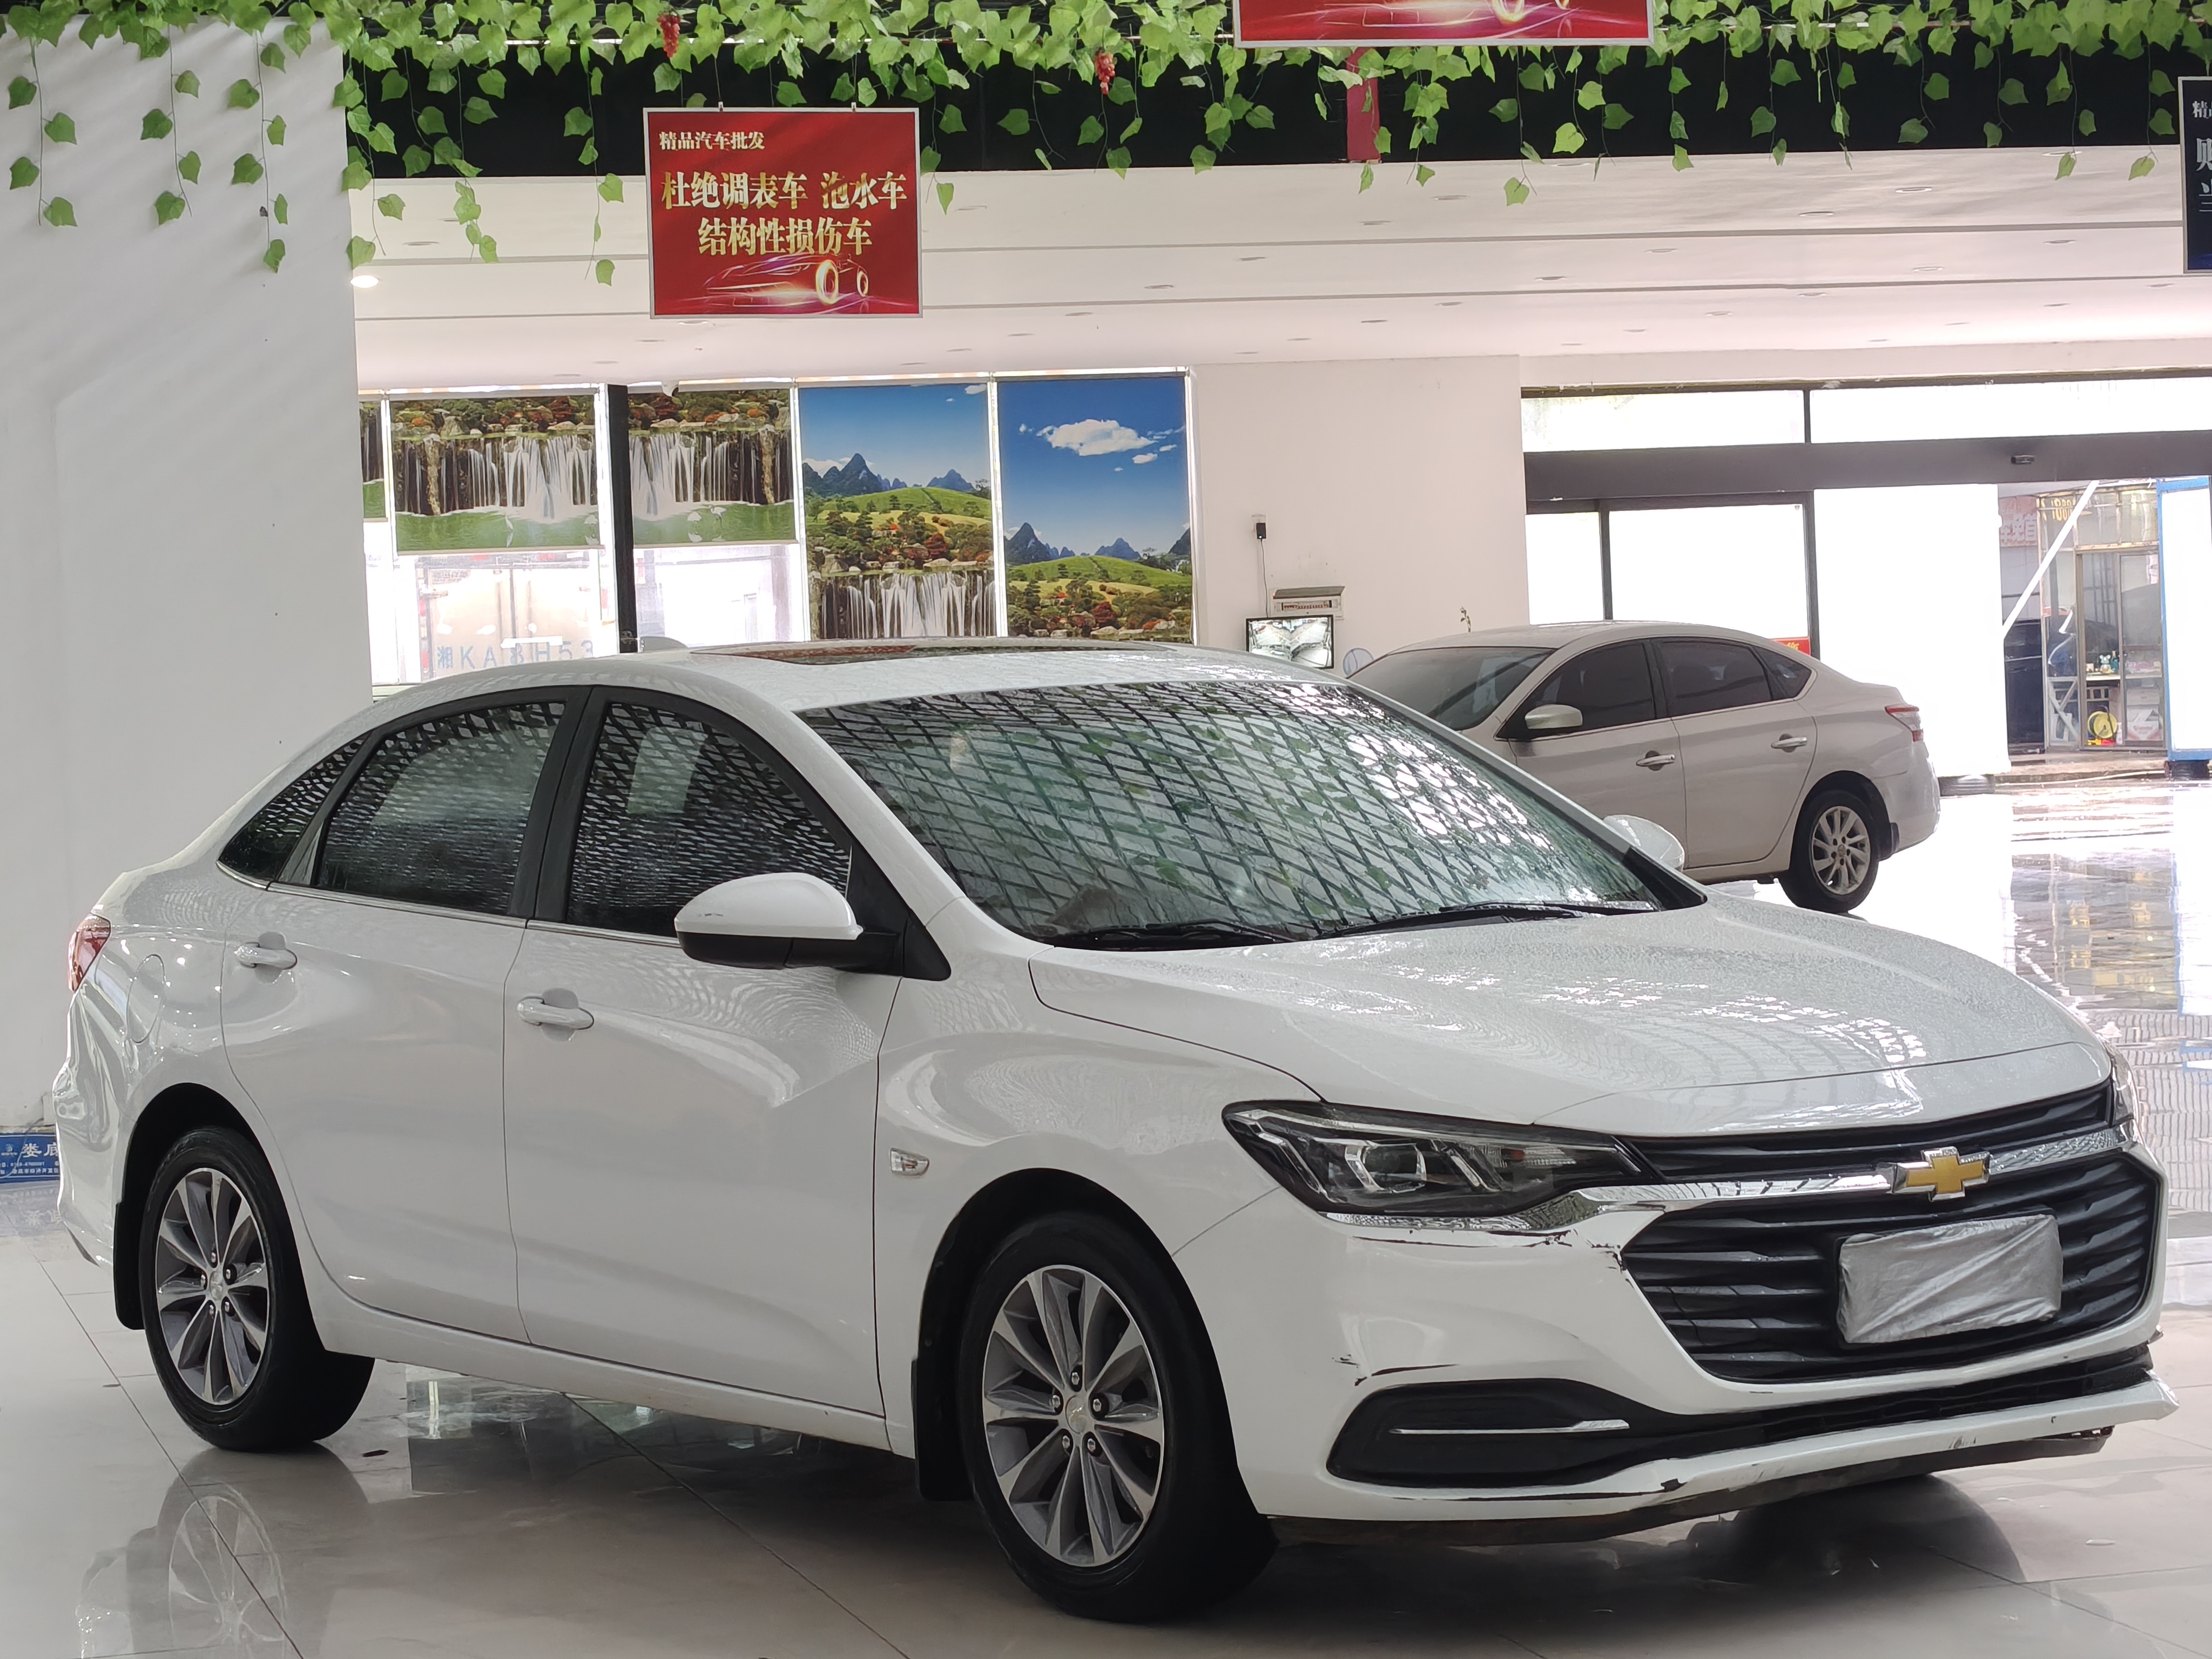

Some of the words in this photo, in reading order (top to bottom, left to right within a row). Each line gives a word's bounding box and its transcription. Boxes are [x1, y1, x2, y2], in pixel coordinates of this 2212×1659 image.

[2192, 100, 2212, 119] 精
[659, 131, 766, 151] 精品汽车批发
[661, 171, 808, 210] 杜绝调表车
[820, 171, 907, 210] 泡水车
[698, 217, 873, 256] 结构性损伤车
